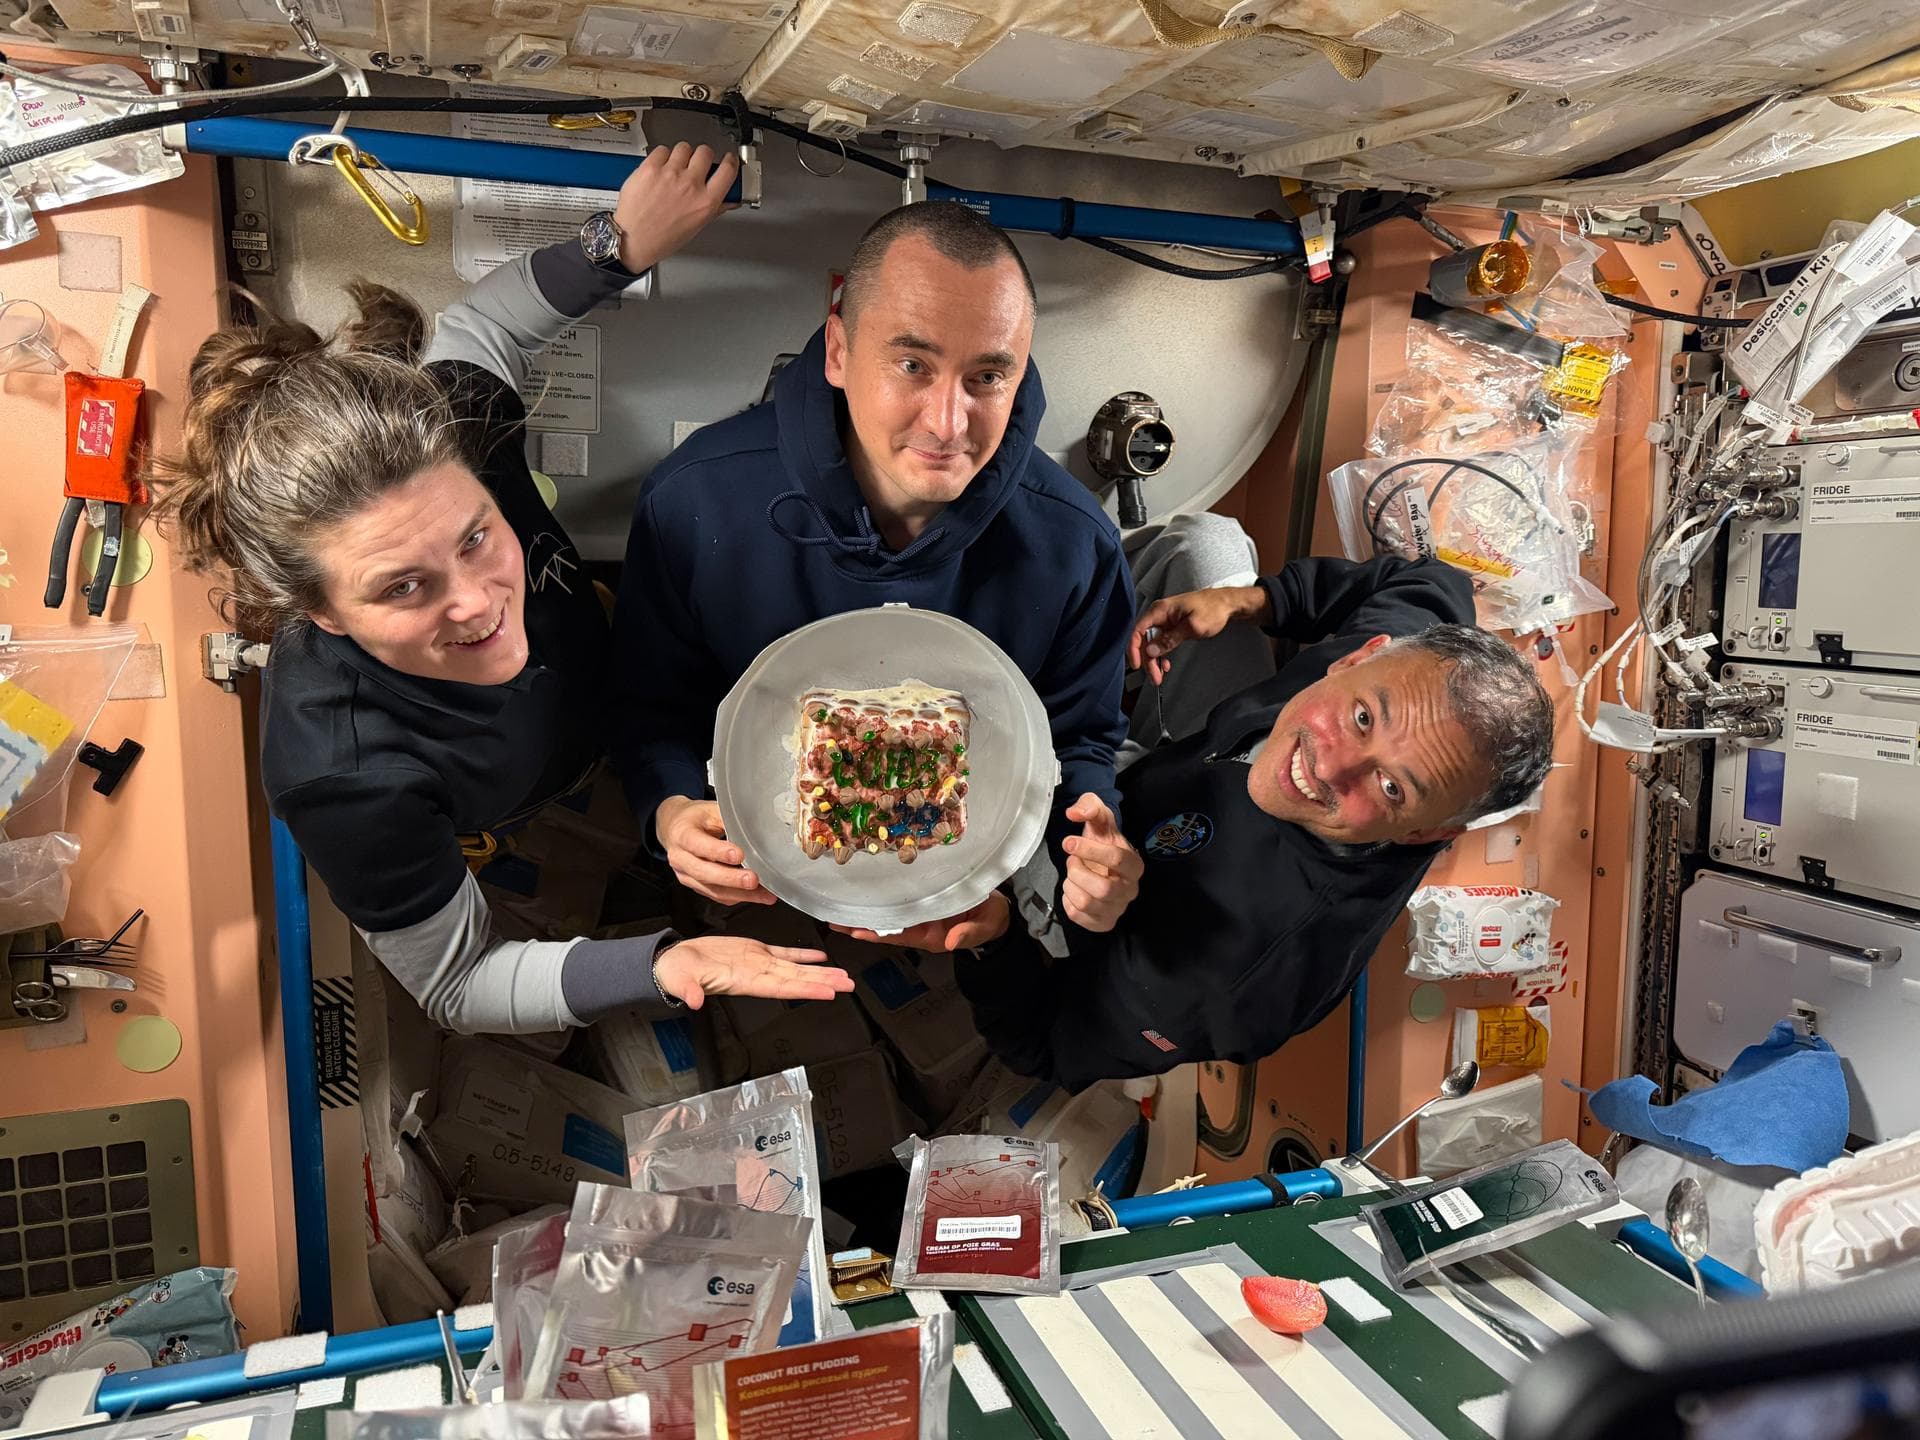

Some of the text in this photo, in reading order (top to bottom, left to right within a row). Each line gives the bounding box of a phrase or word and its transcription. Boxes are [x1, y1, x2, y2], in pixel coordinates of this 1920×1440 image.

[1742, 289, 1797, 353] Desiccant
[1809, 254, 1831, 275] Kit
[95, 408, 106, 449] EMERGENCY
[1813, 485, 1851, 495] FRIDGE
[1797, 713, 1833, 725] FRIDGE
[1756, 824, 1772, 832] POWER
[1464, 886, 1519, 897] HUGGIES
[323, 1010, 334, 1079] REMOVE BEFORE
[331, 1009, 342, 1077] HATCH CLOSURE
[769, 1130, 792, 1145] esa
[1015, 1139, 1035, 1147] esa
[926, 1244, 950, 1252] CREAM
[726, 1280, 755, 1295] esa
[104, 1362, 117, 1376] ES
[737, 1355, 860, 1387] COCONUT RICE PUDDING
[738, 1365, 889, 1401] Кокосовый рисовый пудинг
